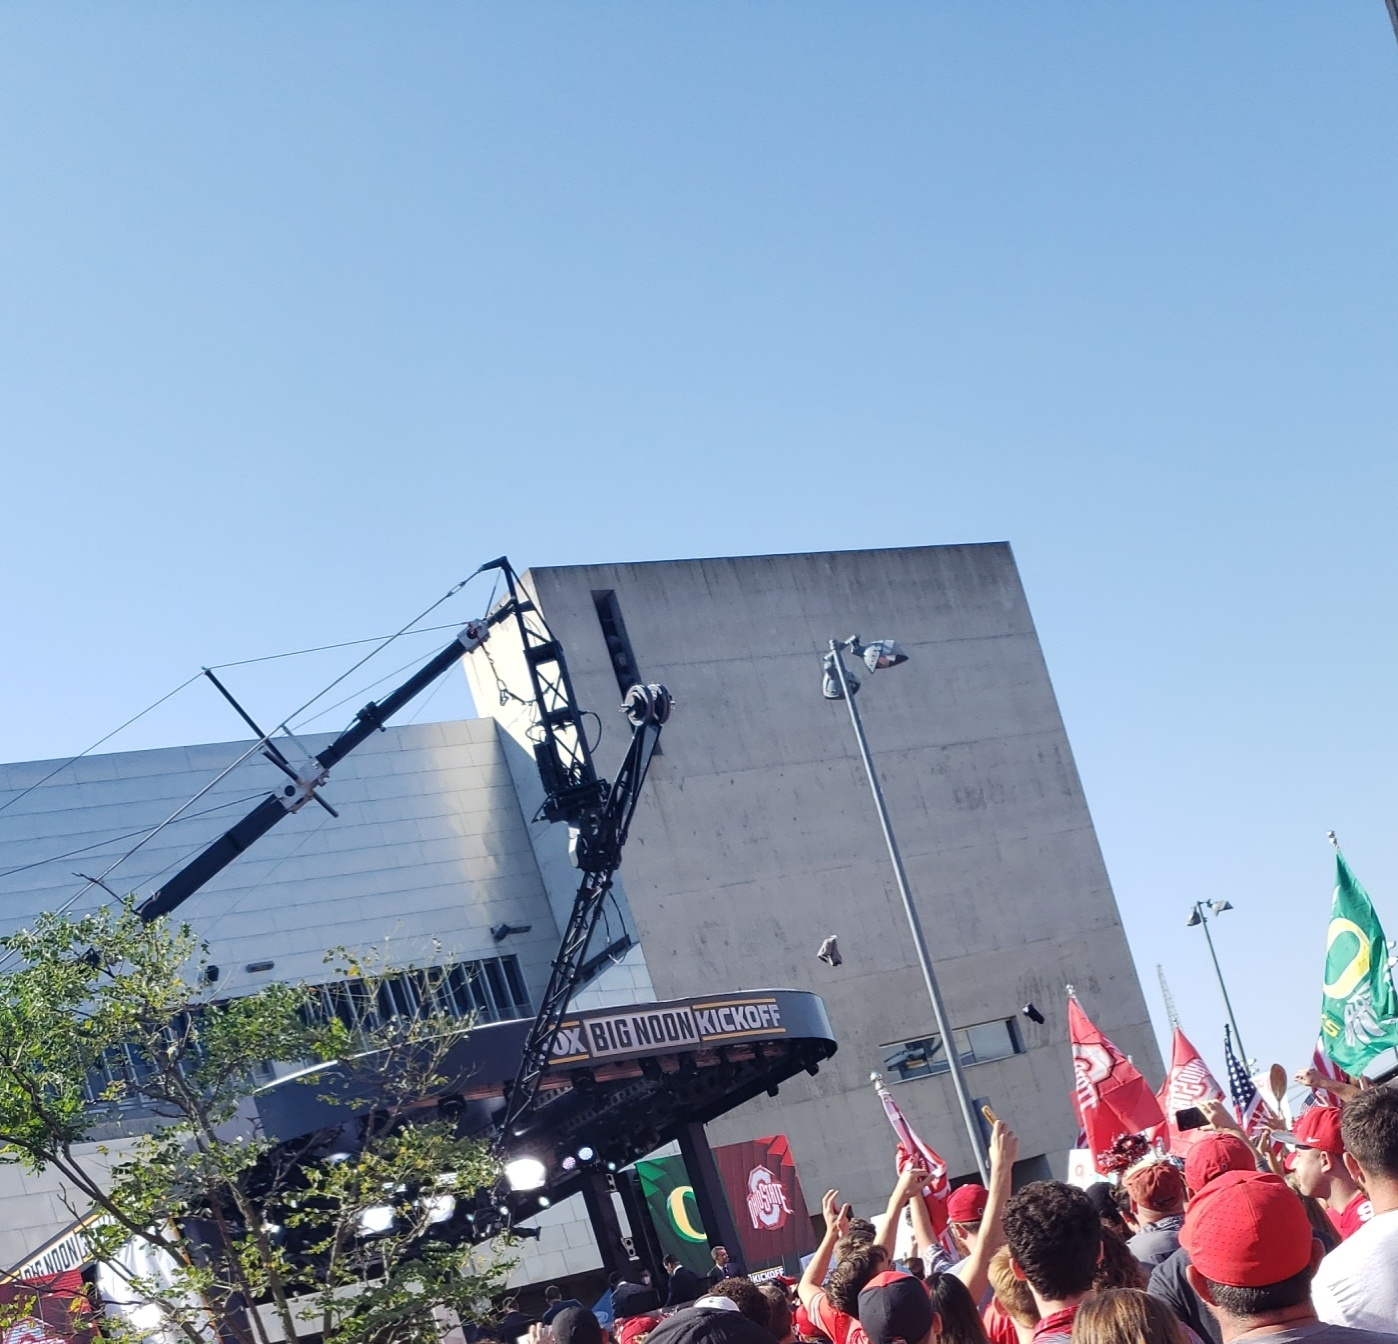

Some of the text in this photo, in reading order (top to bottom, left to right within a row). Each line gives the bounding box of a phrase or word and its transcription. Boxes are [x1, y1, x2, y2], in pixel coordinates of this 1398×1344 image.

[542, 1004, 781, 1058] OX BIG NOON KICKOFF
